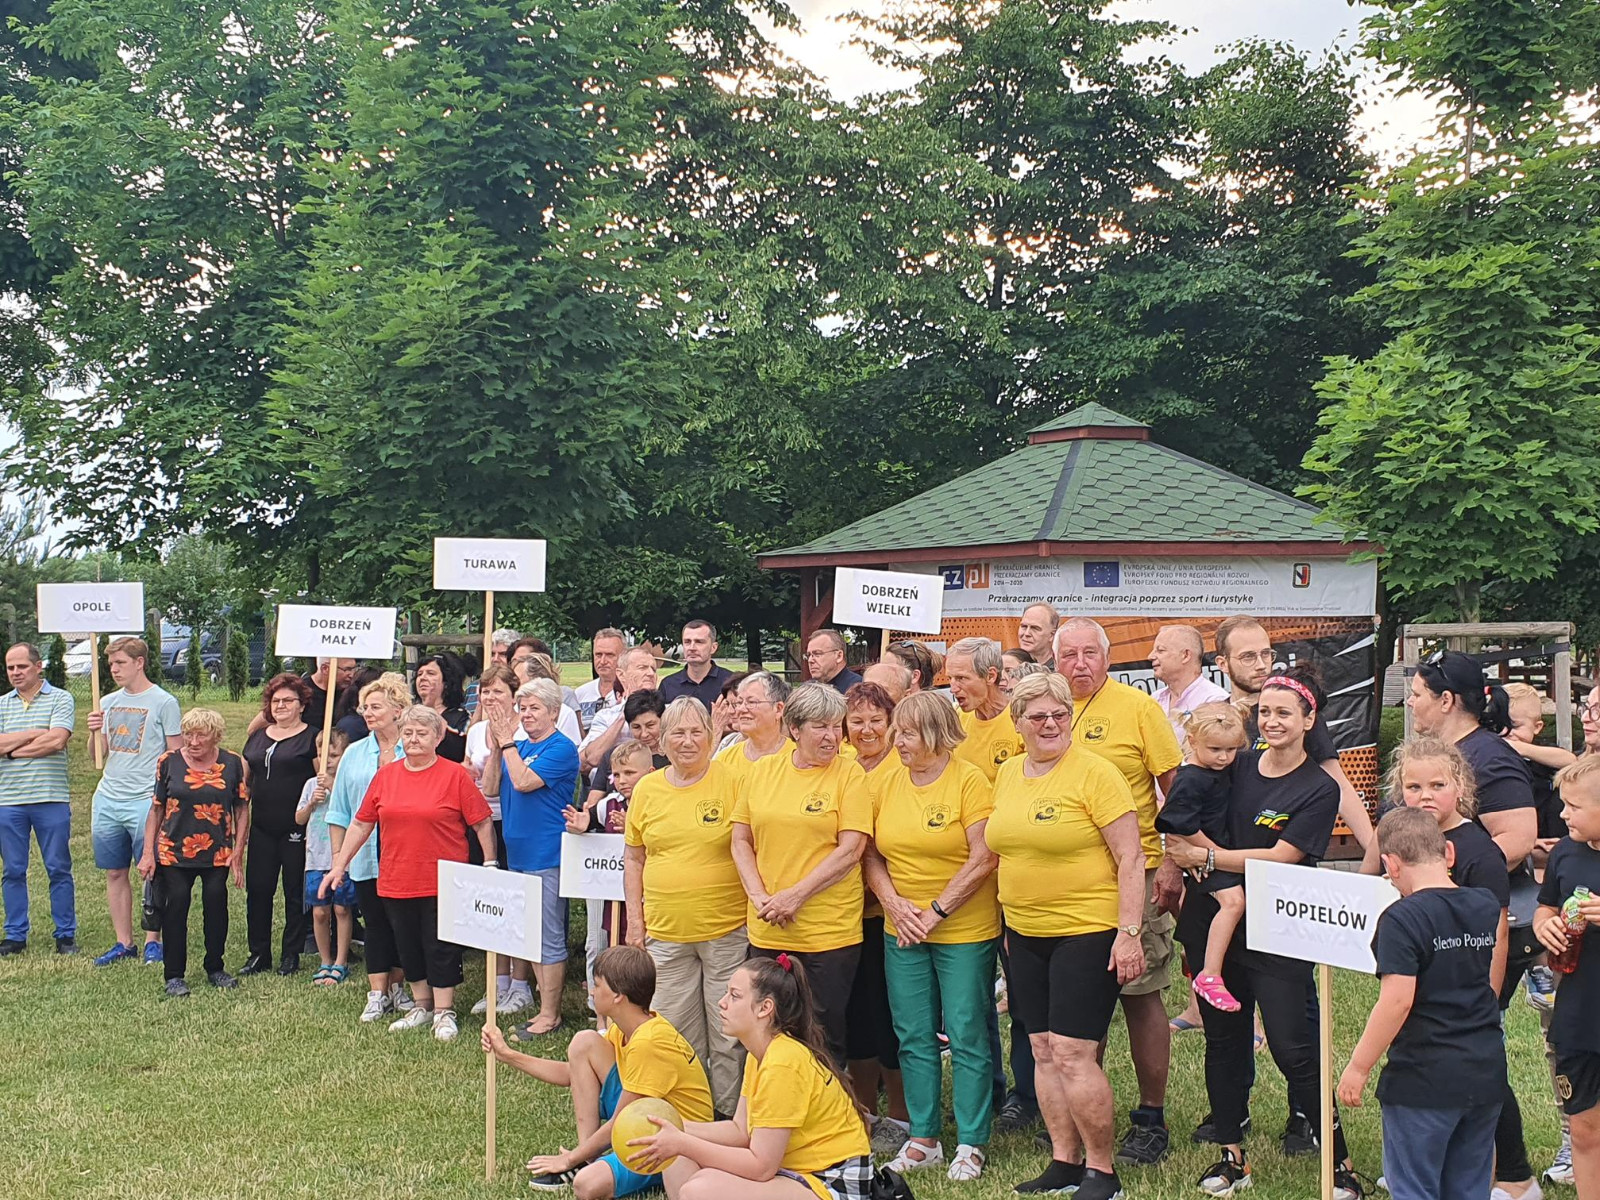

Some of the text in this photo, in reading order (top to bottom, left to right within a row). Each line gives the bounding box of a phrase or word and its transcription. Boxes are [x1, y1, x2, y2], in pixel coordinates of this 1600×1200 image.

[464, 558, 517, 570] TURAWA
[863, 584, 919, 600] DOBRZEŃ
[988, 593, 1044, 603] Przekraczamy
[1047, 593, 1083, 604] granice
[1091, 593, 1137, 604] integracja
[1139, 594, 1176, 605] poprzez
[1178, 594, 1204, 605] sport
[1205, 594, 1210, 603] i
[1210, 594, 1254, 605] turystykę
[73, 602, 111, 612] OPOLE
[866, 602, 912, 617] WIELKI
[309, 618, 371, 631] DOBRZEŃ
[321, 634, 357, 646] MAŁY
[474, 900, 504, 918] Krnov
[1276, 898, 1367, 931] POPIELÓW
